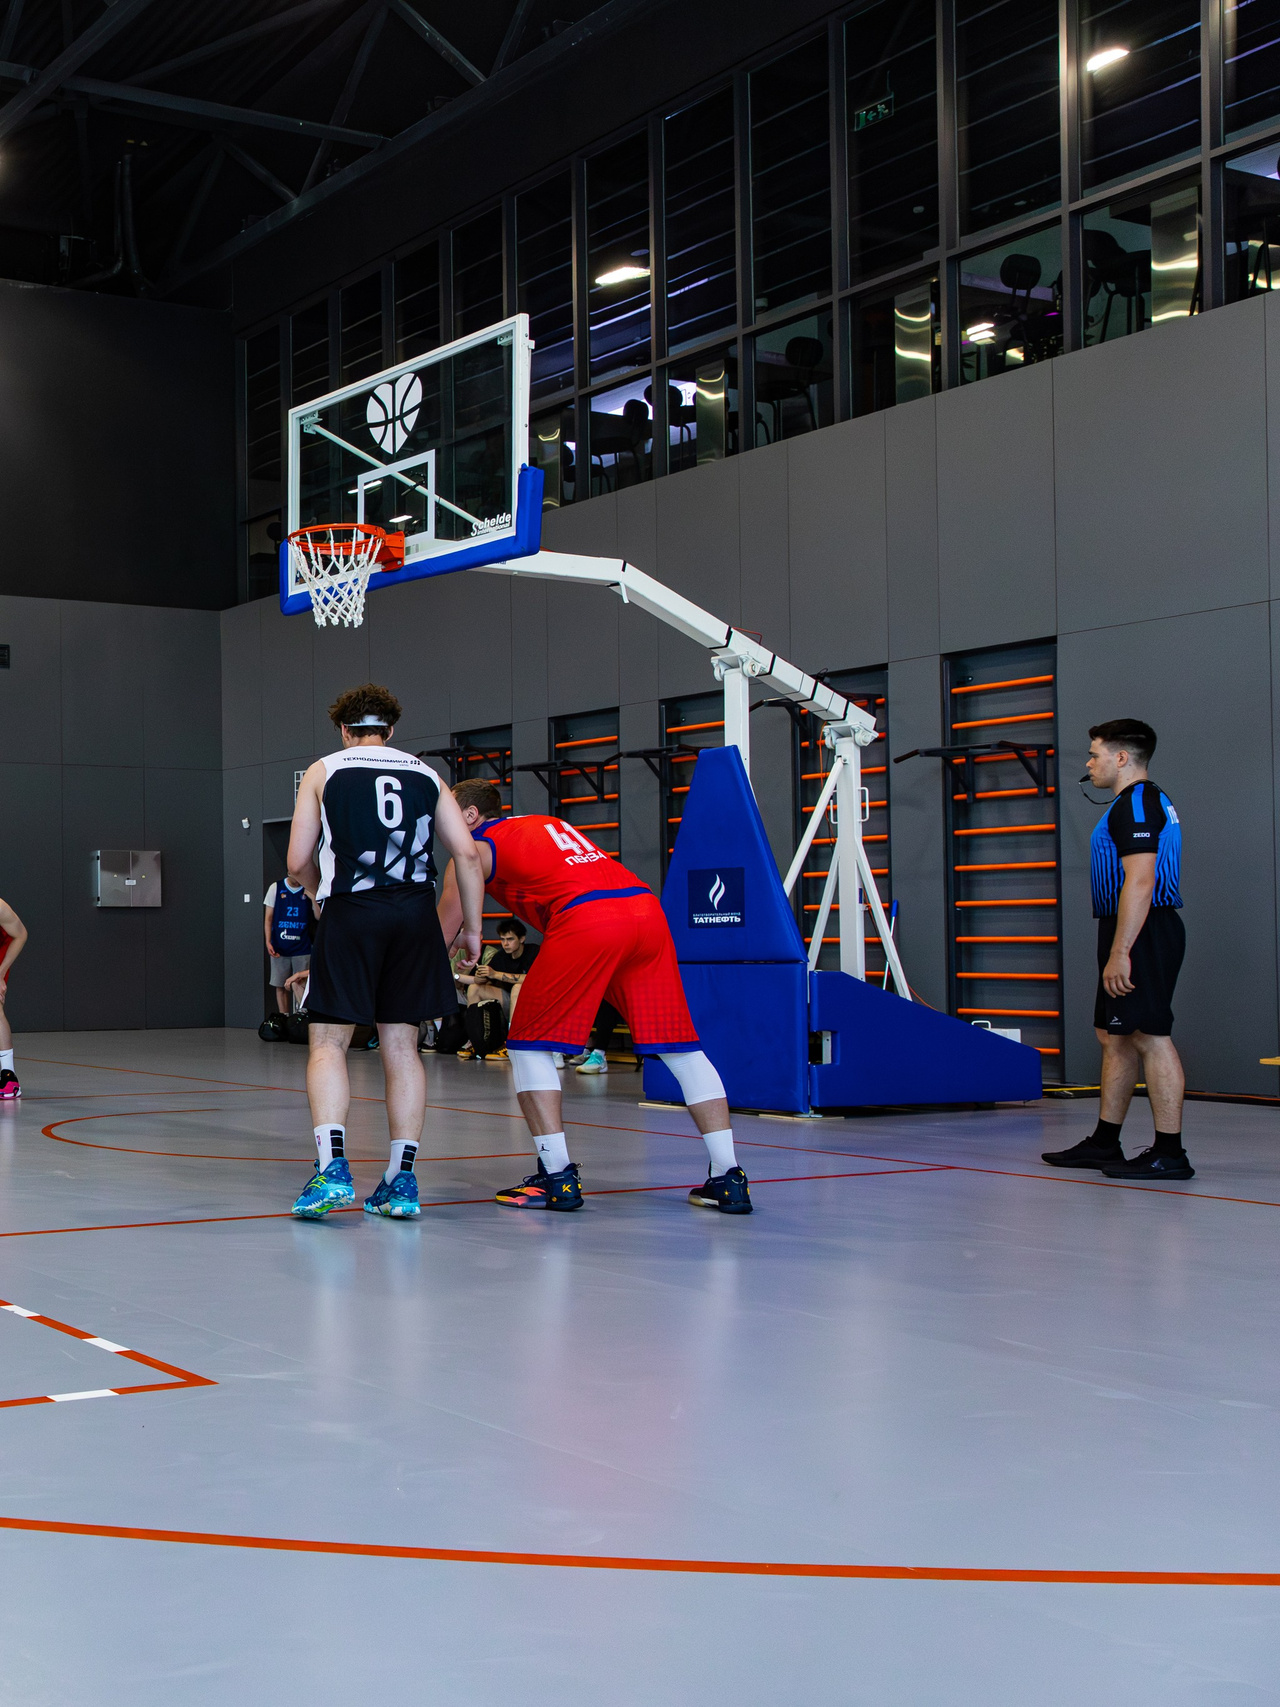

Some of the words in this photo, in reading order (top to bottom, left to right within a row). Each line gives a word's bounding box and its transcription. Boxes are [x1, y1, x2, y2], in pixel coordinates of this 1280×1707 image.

[471, 512, 512, 537] Schelde
[375, 775, 404, 829] 6
[544, 821, 596, 855] 41
[564, 850, 608, 866] ПЕНЗА
[287, 906, 299, 917] 23
[278, 921, 306, 929] ZENIT
[693, 916, 741, 924] ТАТНЕФТЬ
